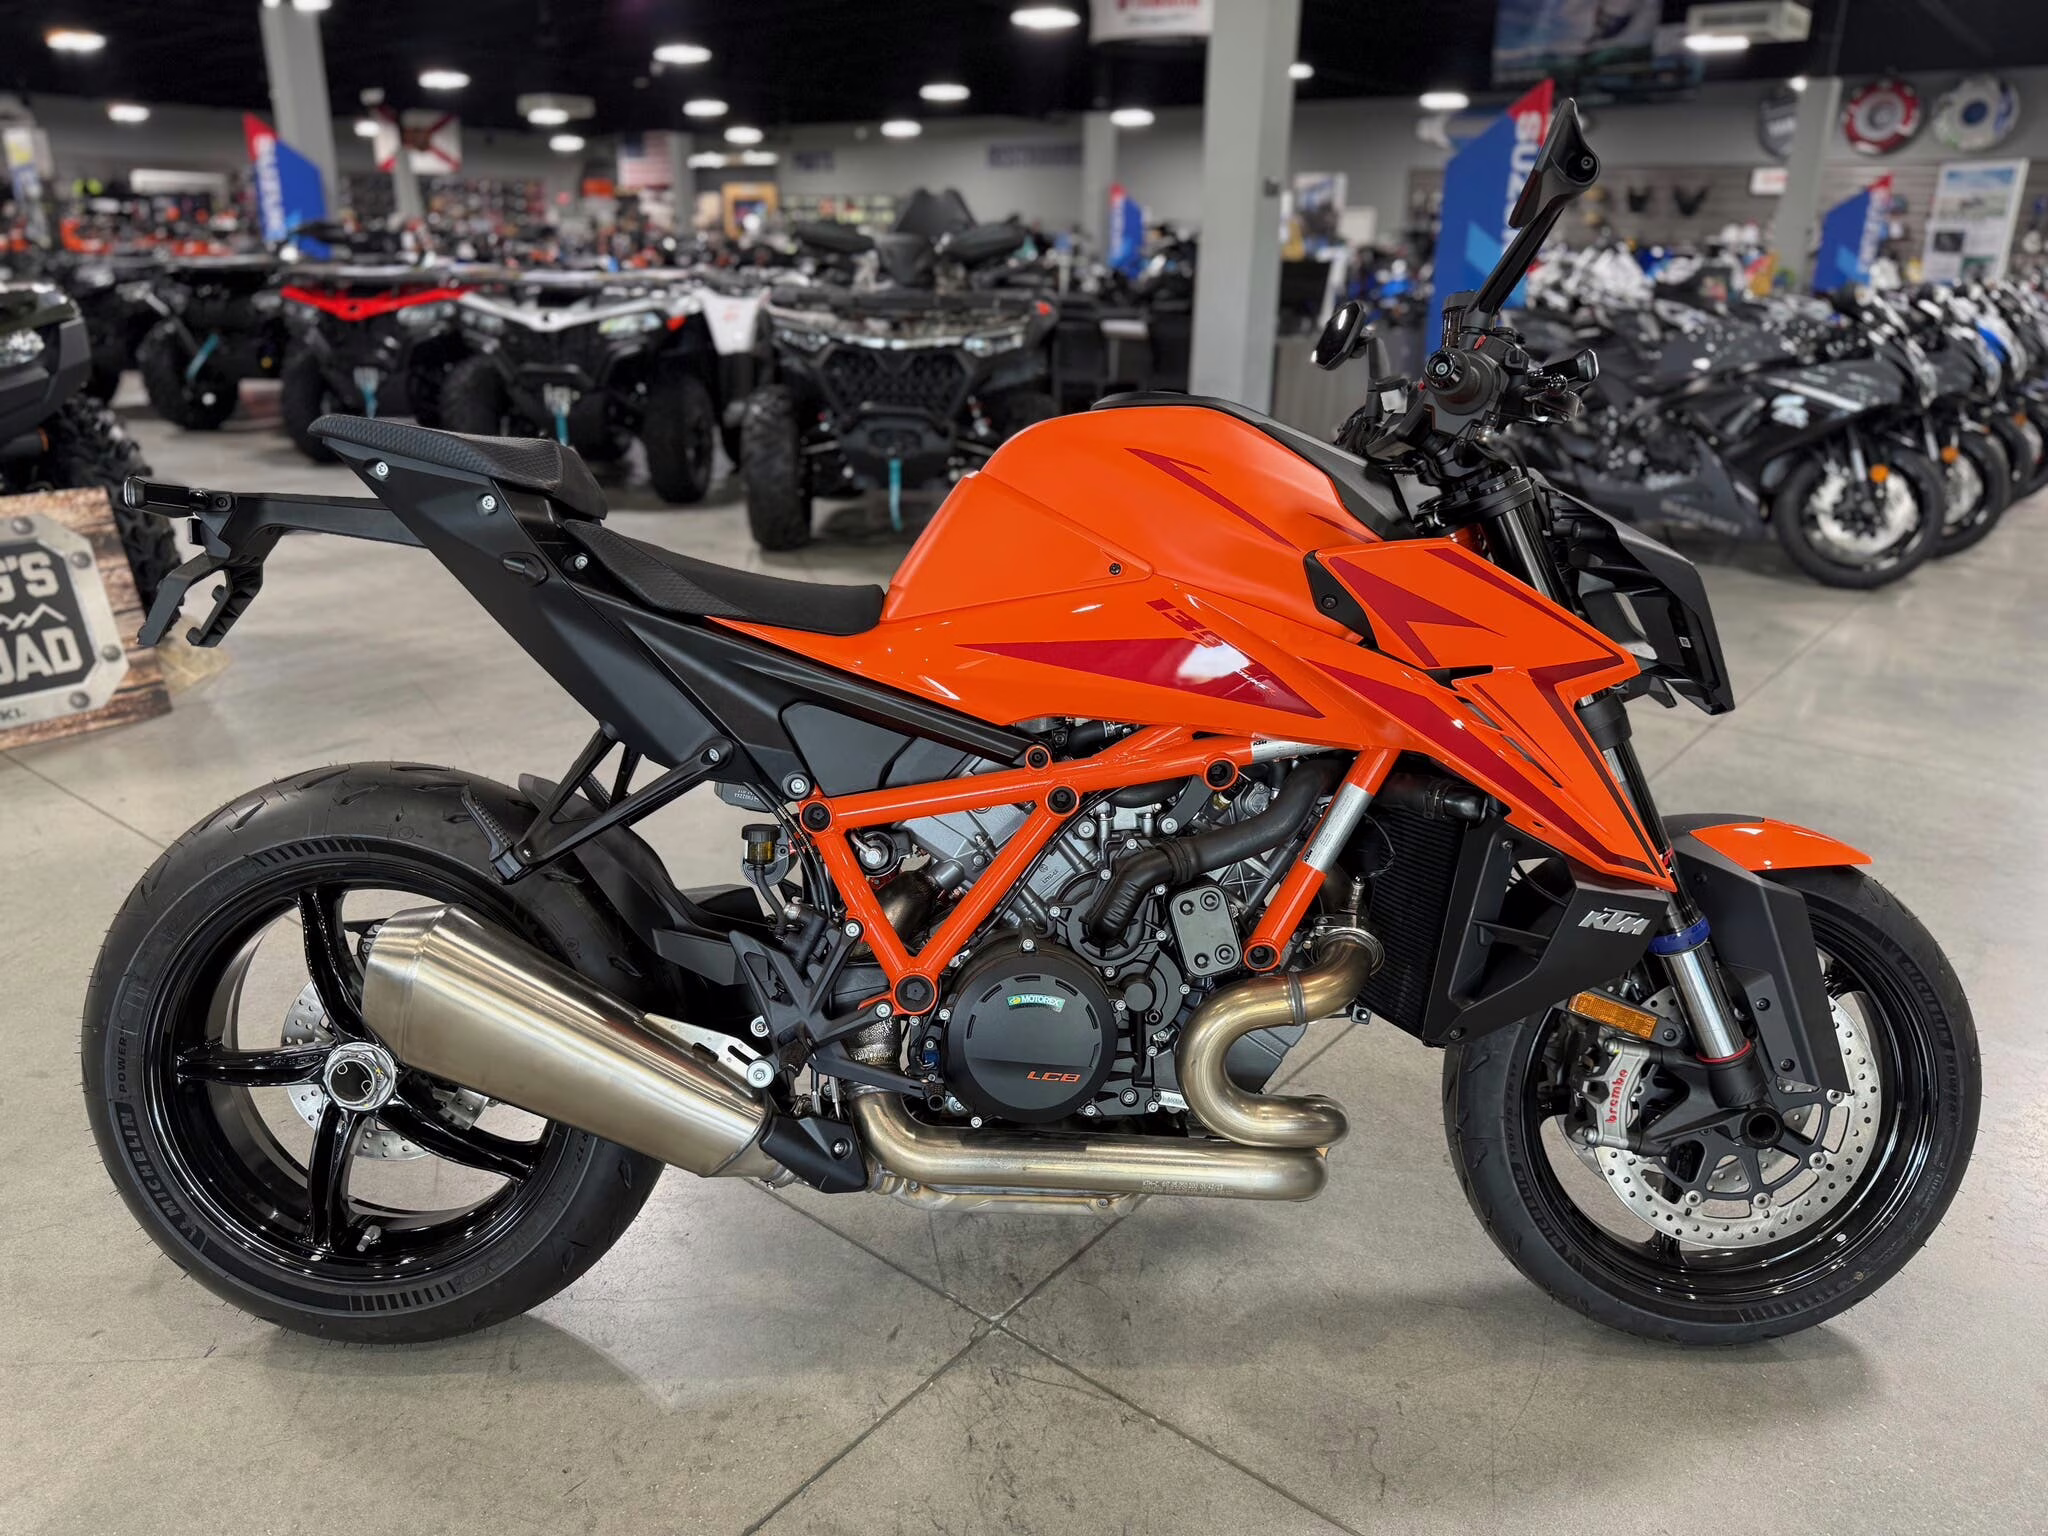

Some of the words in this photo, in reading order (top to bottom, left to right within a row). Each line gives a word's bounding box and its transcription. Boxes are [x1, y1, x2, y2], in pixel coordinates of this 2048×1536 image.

[1577, 907, 1651, 936] KTM
[1021, 994, 1060, 1007] MOTOREX
[117, 1036, 128, 1094] POWER
[1027, 1071, 1081, 1083] LC8
[1605, 1069, 1629, 1125] brembo
[120, 1111, 182, 1218] MICHELIN
